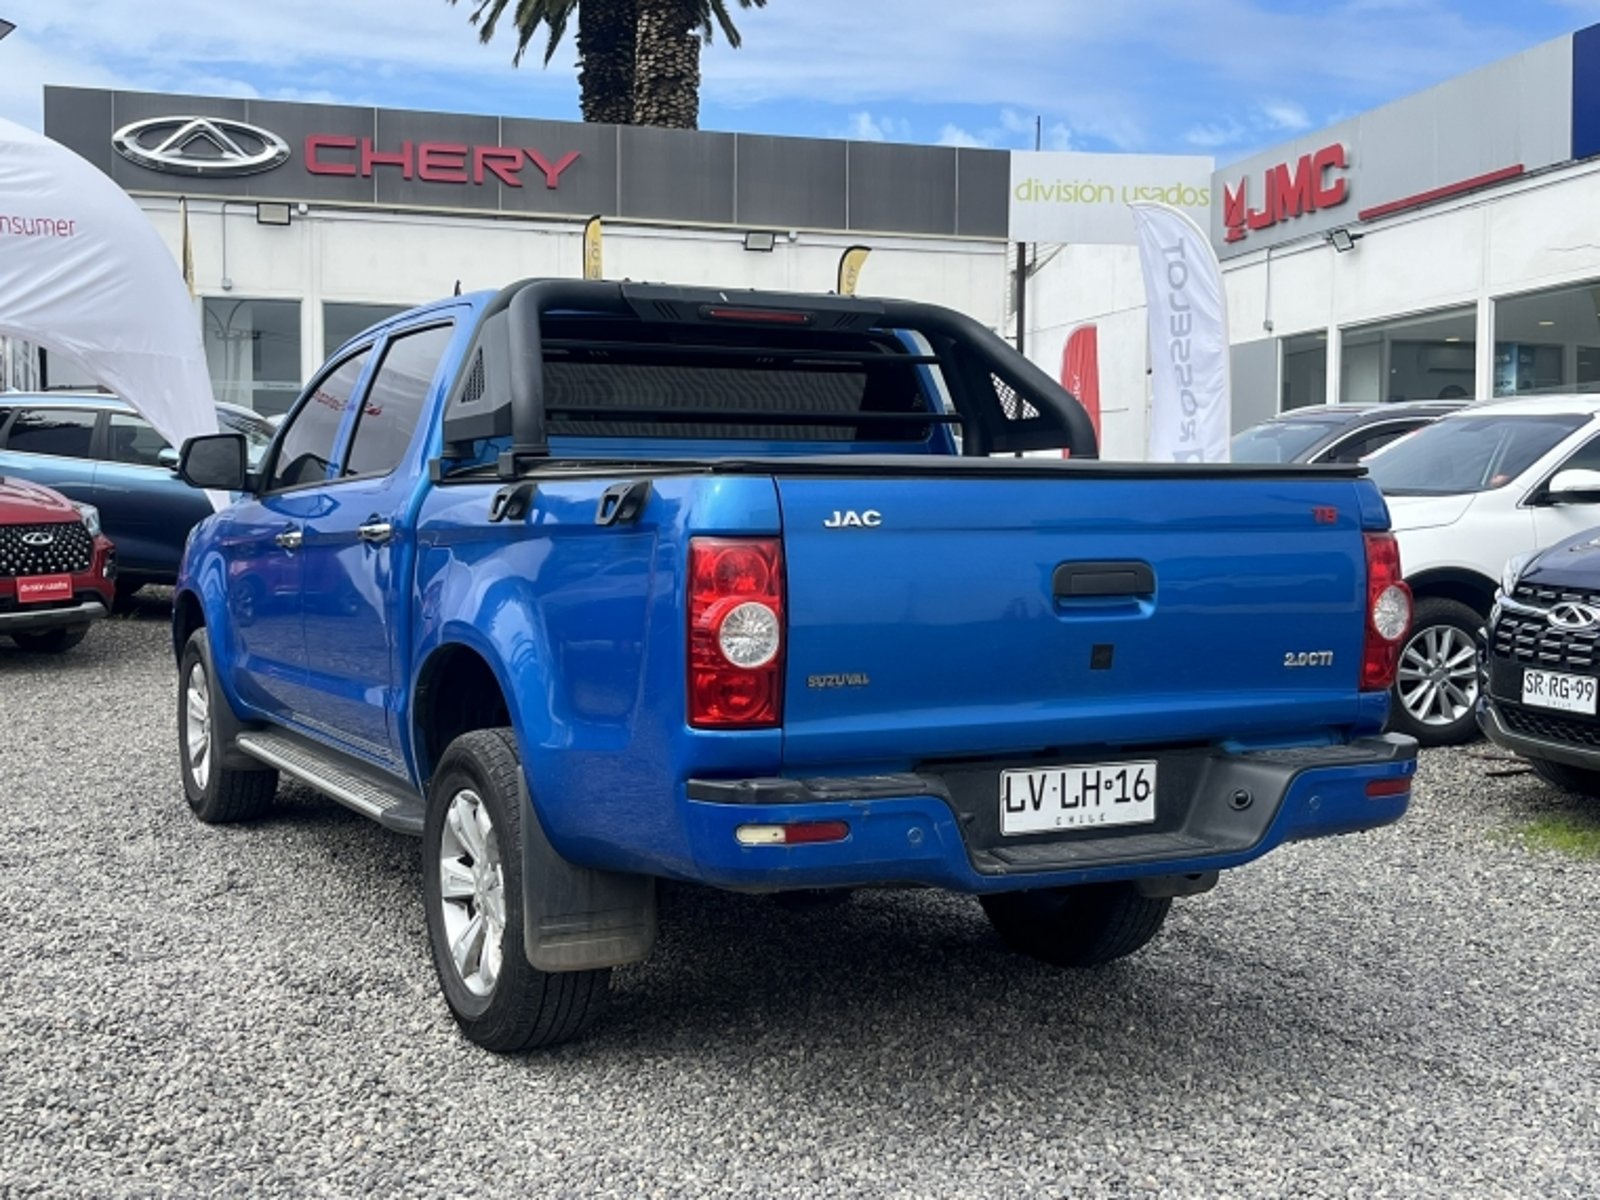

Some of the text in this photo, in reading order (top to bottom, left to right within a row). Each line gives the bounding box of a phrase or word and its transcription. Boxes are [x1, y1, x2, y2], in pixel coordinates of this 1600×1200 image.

[305, 134, 580, 189] CHERY
[1015, 177, 1210, 207] división usados
[1247, 143, 1349, 230] JMC
[0, 215, 76, 237] nsumer
[823, 509, 882, 527] JAC
[1055, 812, 1107, 827] CHILE
